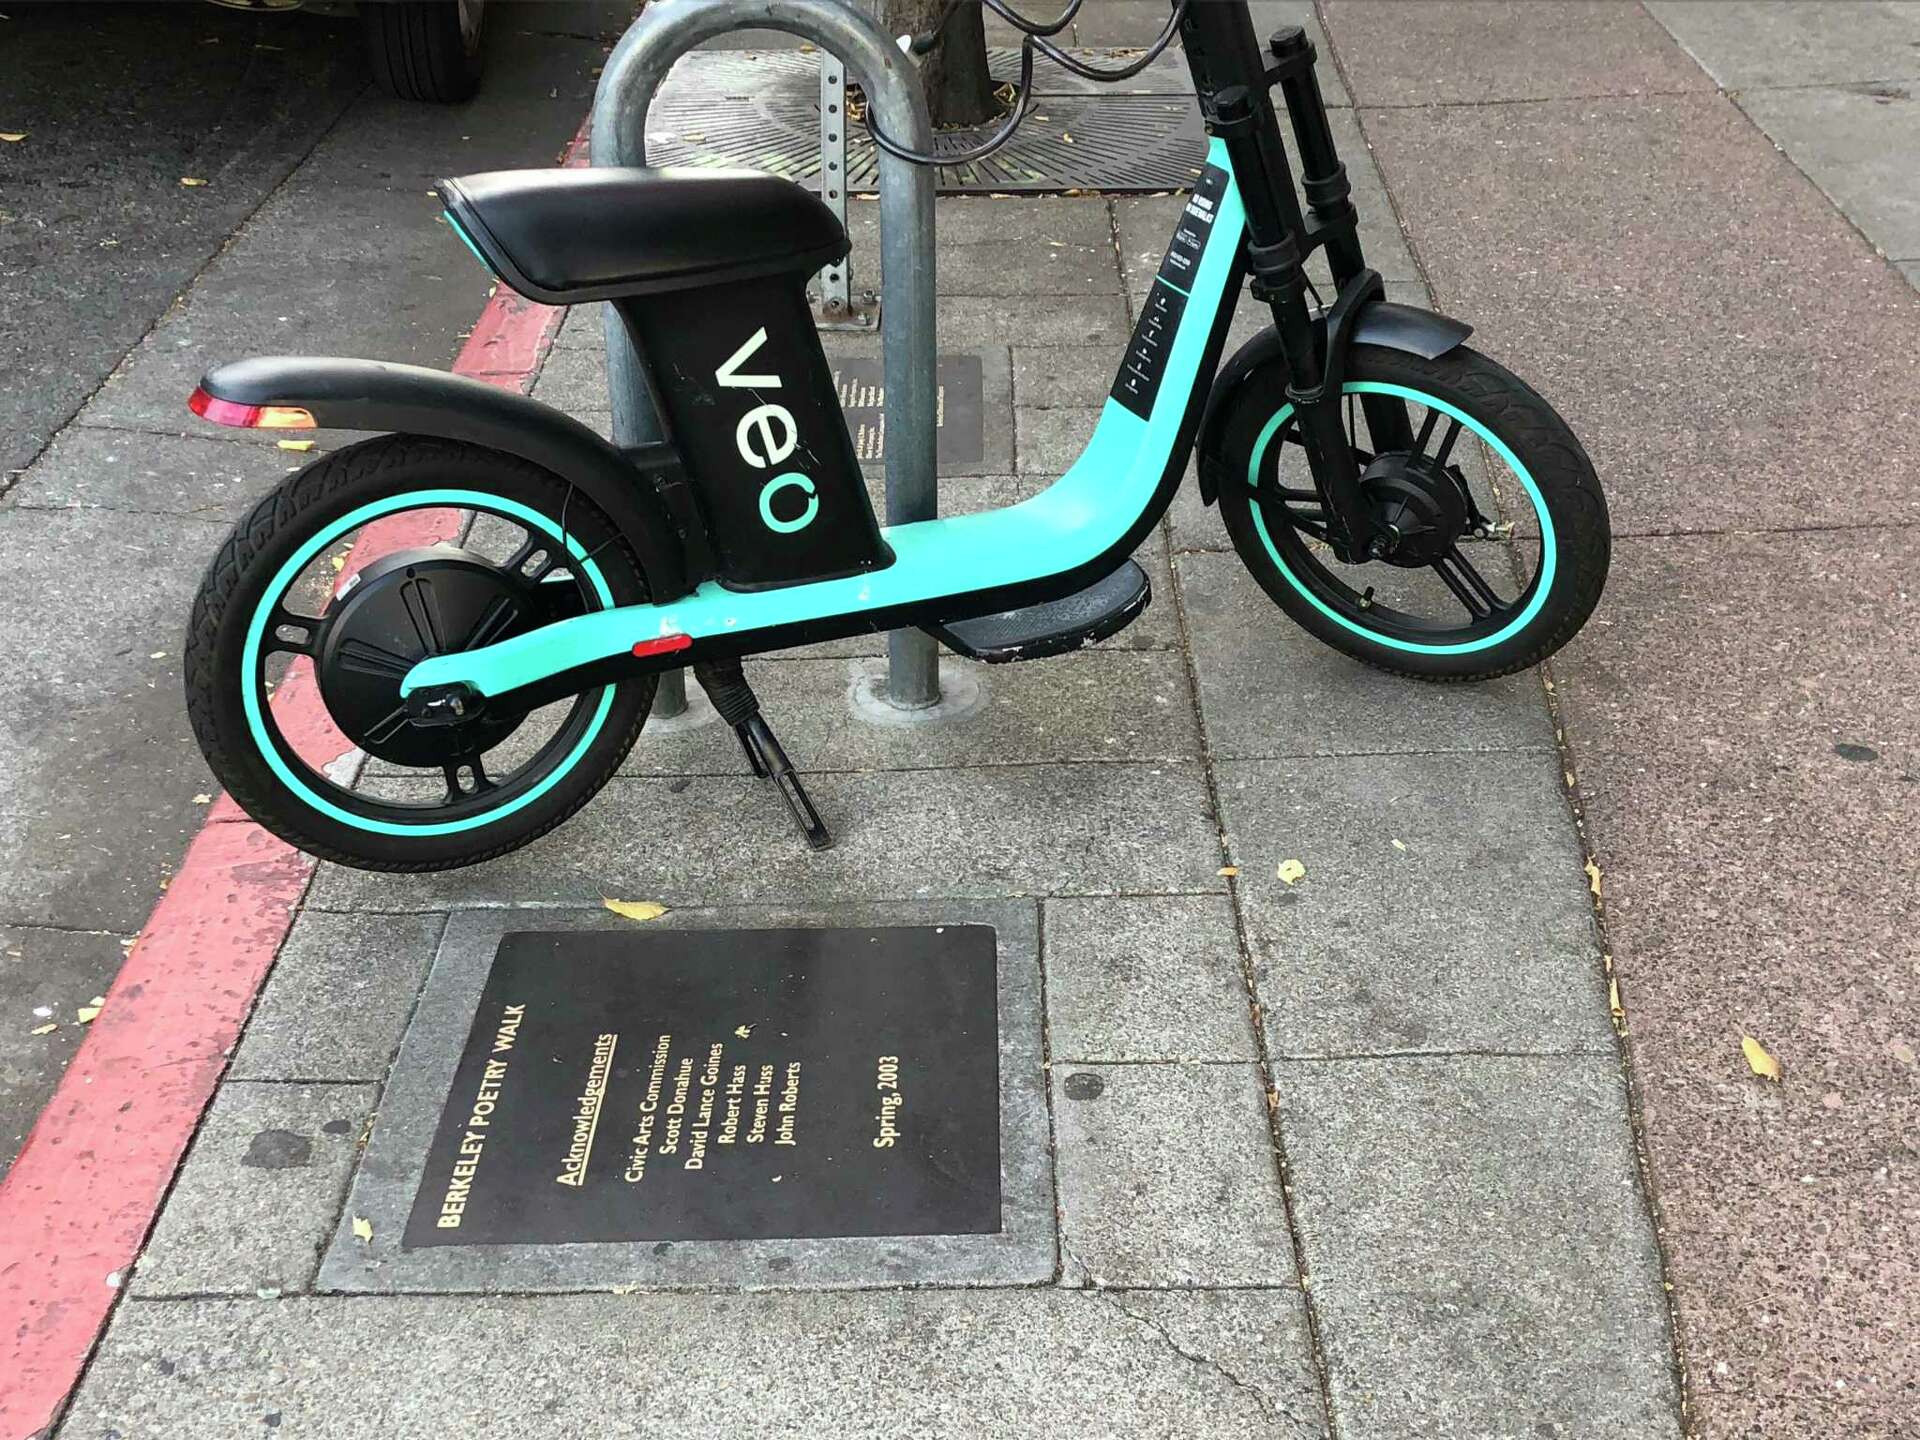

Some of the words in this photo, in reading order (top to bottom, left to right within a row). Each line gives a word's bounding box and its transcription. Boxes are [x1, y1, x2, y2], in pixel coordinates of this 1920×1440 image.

[715, 326, 819, 533] veo
[640, 1034, 671, 1112] Commission
[667, 1057, 693, 1115] Donahue
[700, 1042, 723, 1086] Goines
[753, 1064, 773, 1094] Huss
[779, 1061, 801, 1113] Roberts
[877, 1055, 899, 1091] 2003
[437, 1130, 486, 1228] BERKELEY
[468, 1058, 508, 1127] POETRY
[492, 1003, 526, 1053] WALK
[556, 1032, 615, 1186] Acknowledgements
[691, 1088, 715, 1129] Lance
[717, 1095, 741, 1144] Robert
[729, 1064, 746, 1095] Hass
[746, 1094, 768, 1144] Steven
[873, 1093, 903, 1149] Spring,
[632, 1115, 654, 1146] Arts
[659, 1116, 682, 1155] Scott
[684, 1130, 708, 1170] David
[775, 1113, 796, 1146] John
[624, 1145, 647, 1183] Civic
